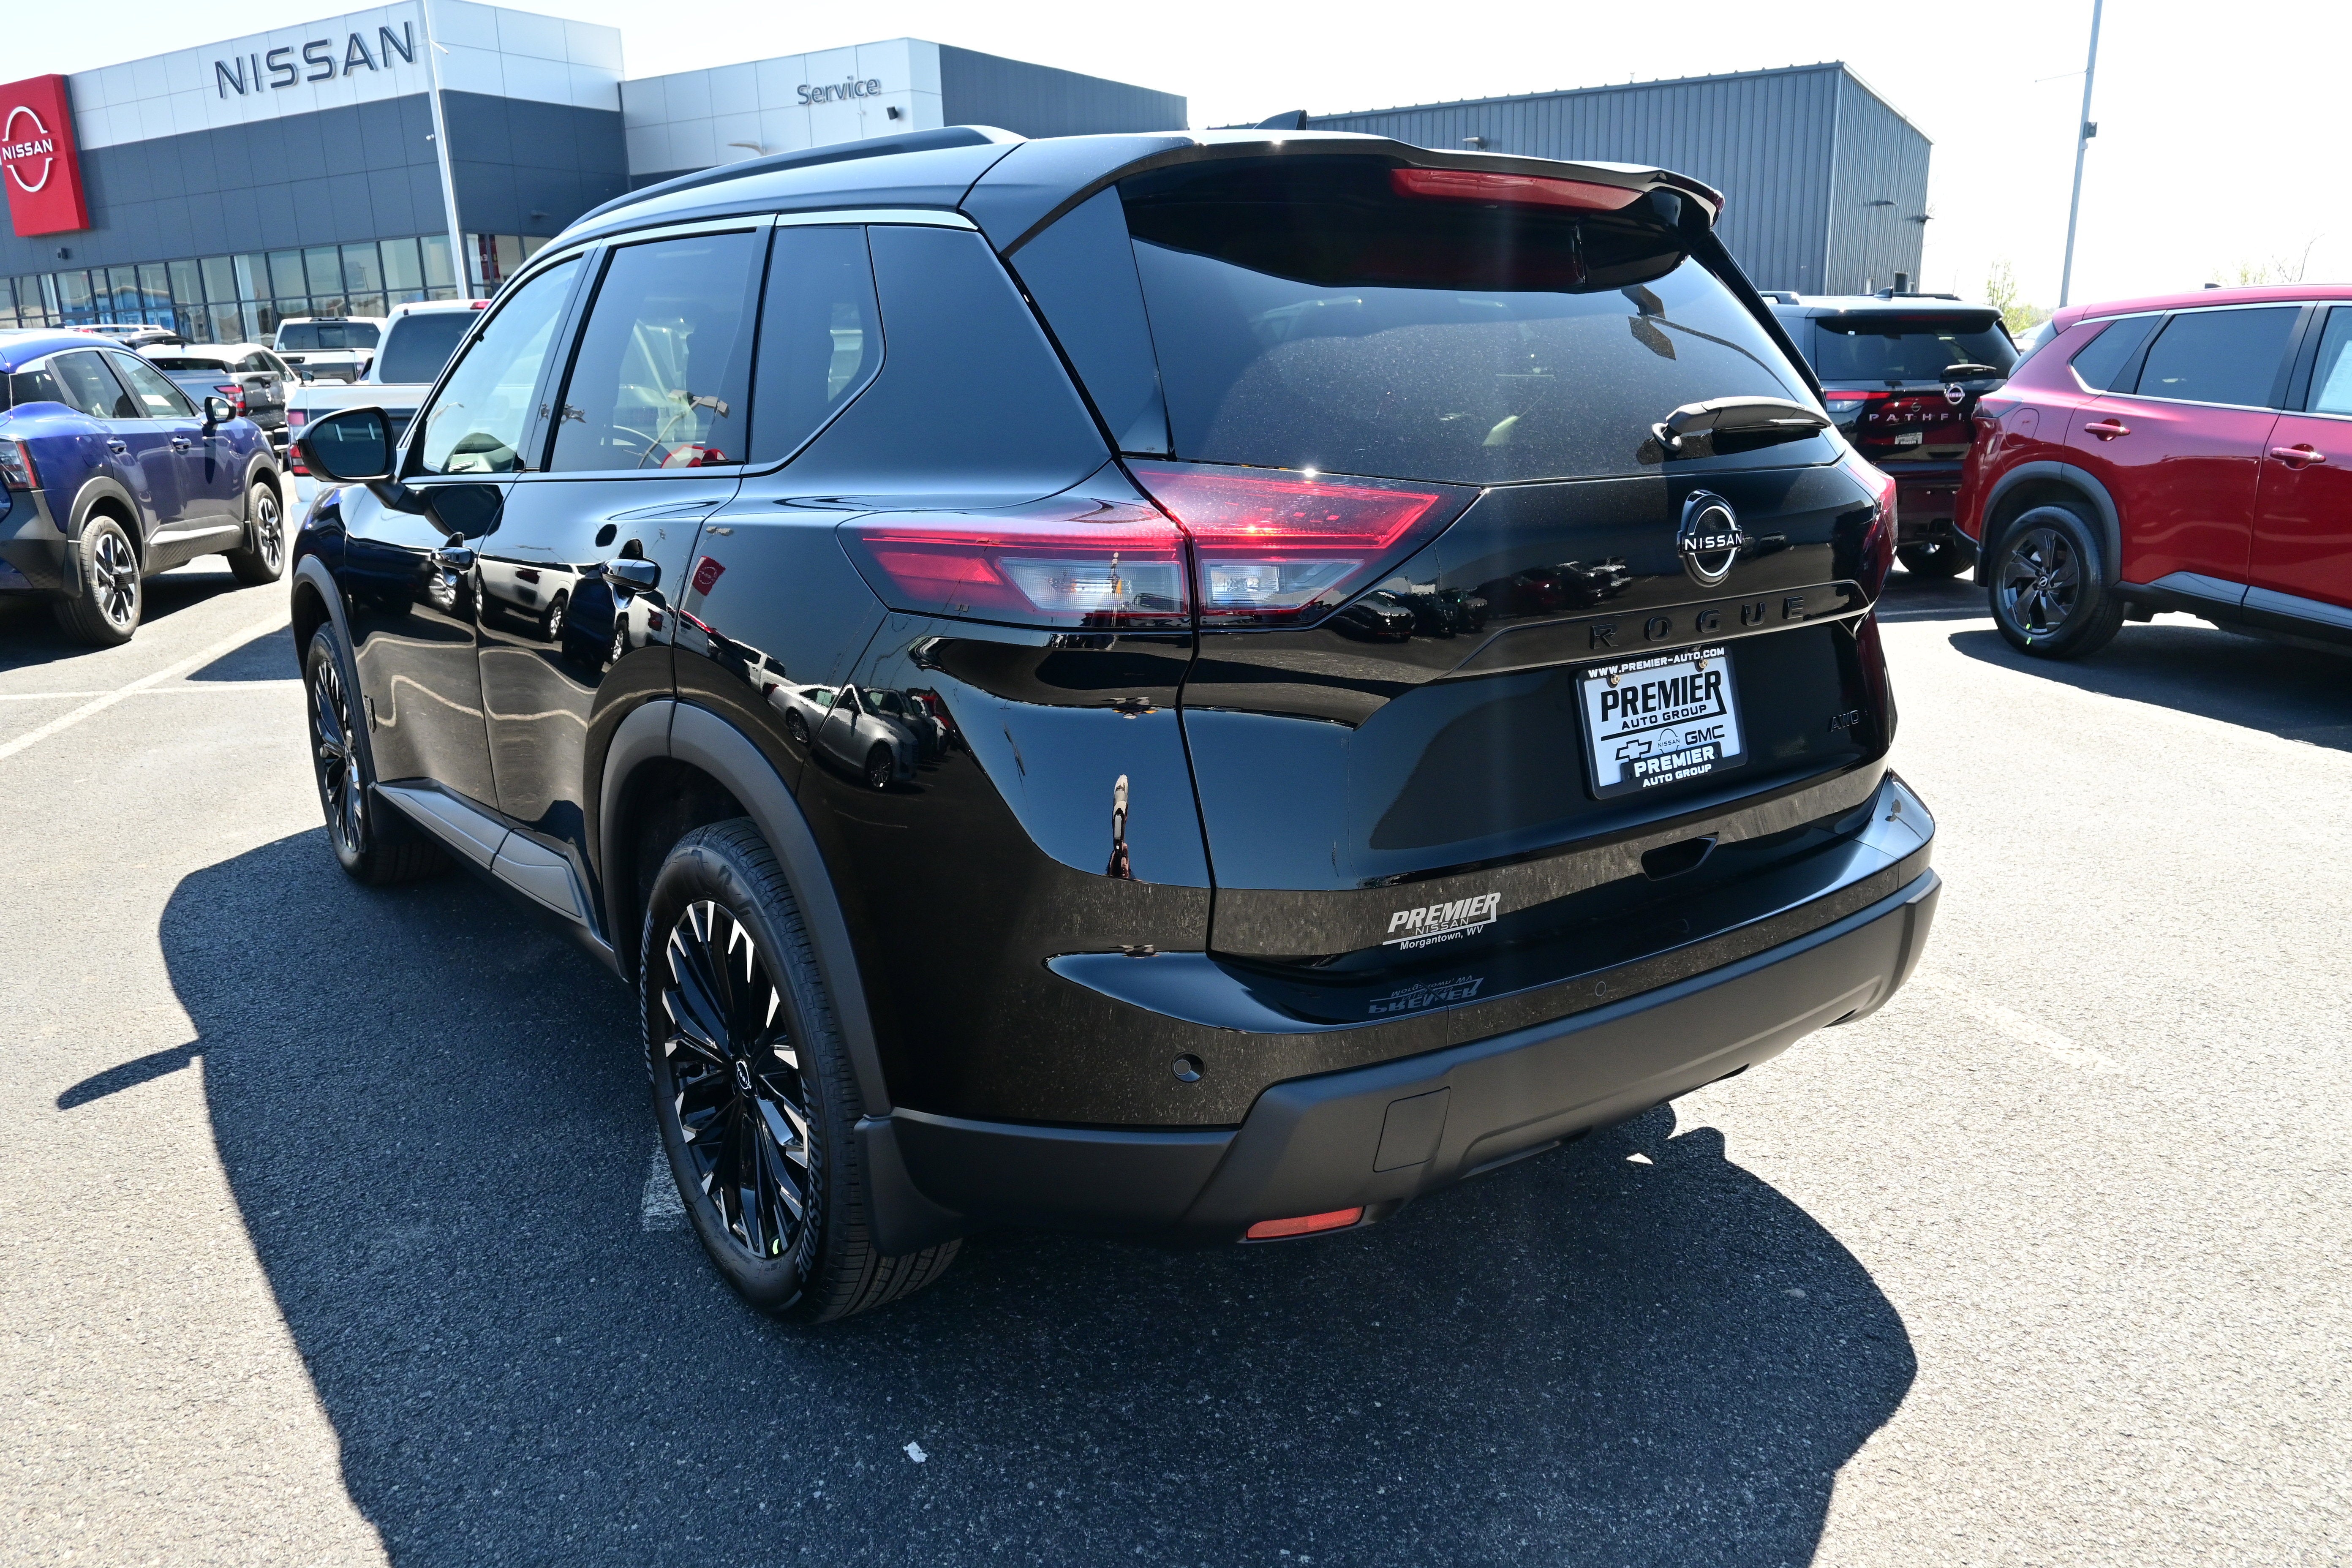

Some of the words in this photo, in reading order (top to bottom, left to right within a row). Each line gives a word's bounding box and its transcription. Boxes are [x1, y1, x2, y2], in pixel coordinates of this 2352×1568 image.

[215, 20, 415, 99] NISSAN
[797, 75, 880, 105] Service
[2, 138, 53, 161] NISSAN
[1869, 413, 1974, 422] PATHFI
[1685, 533, 1742, 550] NISSAN
[1589, 596, 1804, 650] ROGUE
[1588, 647, 1725, 678] WWW.PREMIER-AUTO.COM
[1601, 670, 1727, 722] PREMIER
[1622, 715, 1658, 730] AUTO
[1663, 704, 1707, 721] GROUP
[1831, 710, 1859, 732] AWD
[1658, 738, 1680, 748] NISSAN
[1685, 724, 1725, 745] GMC
[1634, 746, 1715, 777] PREMIER
[1643, 773, 1673, 787] AUTO
[1675, 764, 1712, 779] GROUP
[1387, 892, 1501, 933] PREMIER
[1400, 931, 1463, 950] Morgantown,
[1467, 925, 1484, 936] WV
[1415, 917, 1469, 935] NISSAN
[795, 1075, 822, 1283] BRIDGESTONE
